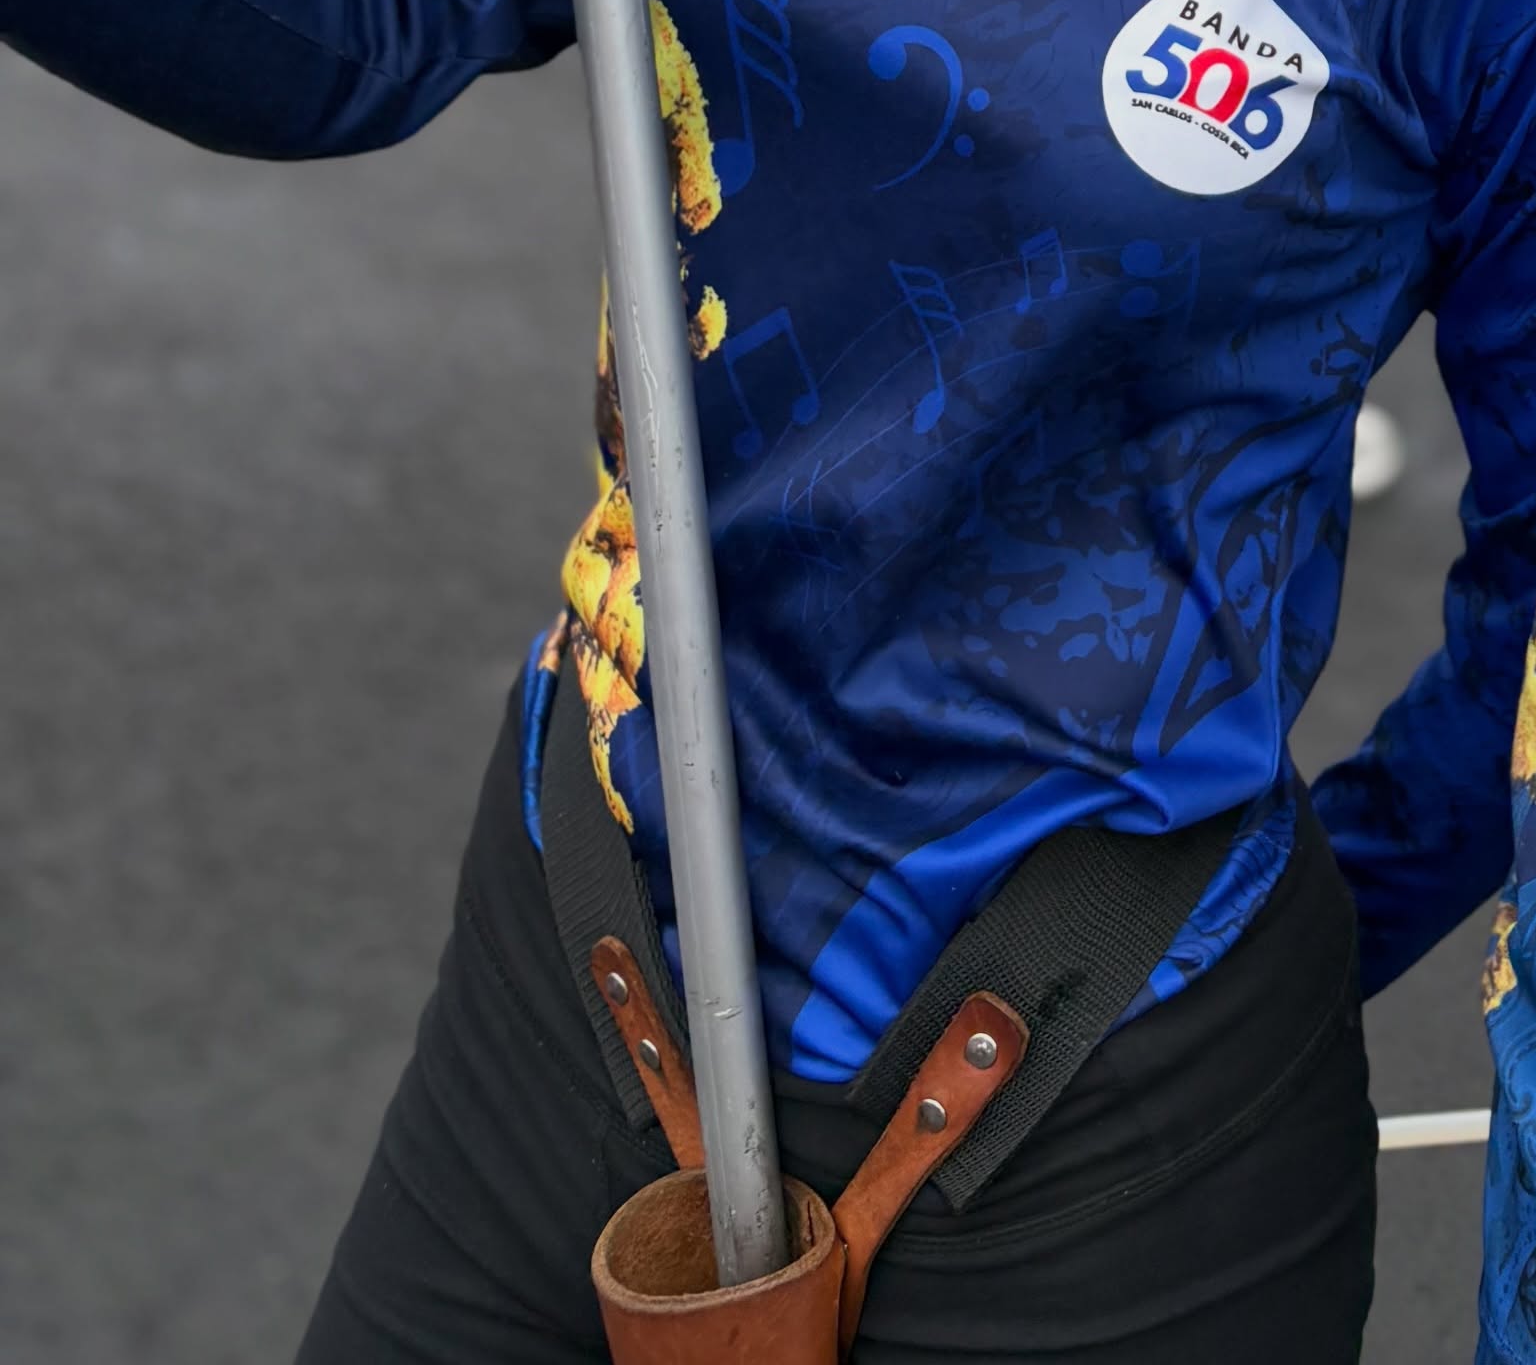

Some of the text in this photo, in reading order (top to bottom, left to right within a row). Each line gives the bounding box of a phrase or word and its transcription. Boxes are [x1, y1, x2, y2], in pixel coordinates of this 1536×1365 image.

[1125, 23, 1299, 151] 506
[1131, 97, 1153, 112] SAN
[1154, 103, 1193, 124] CARLOS
[1200, 122, 1230, 144] COSTA
[1230, 140, 1250, 160] RICA
